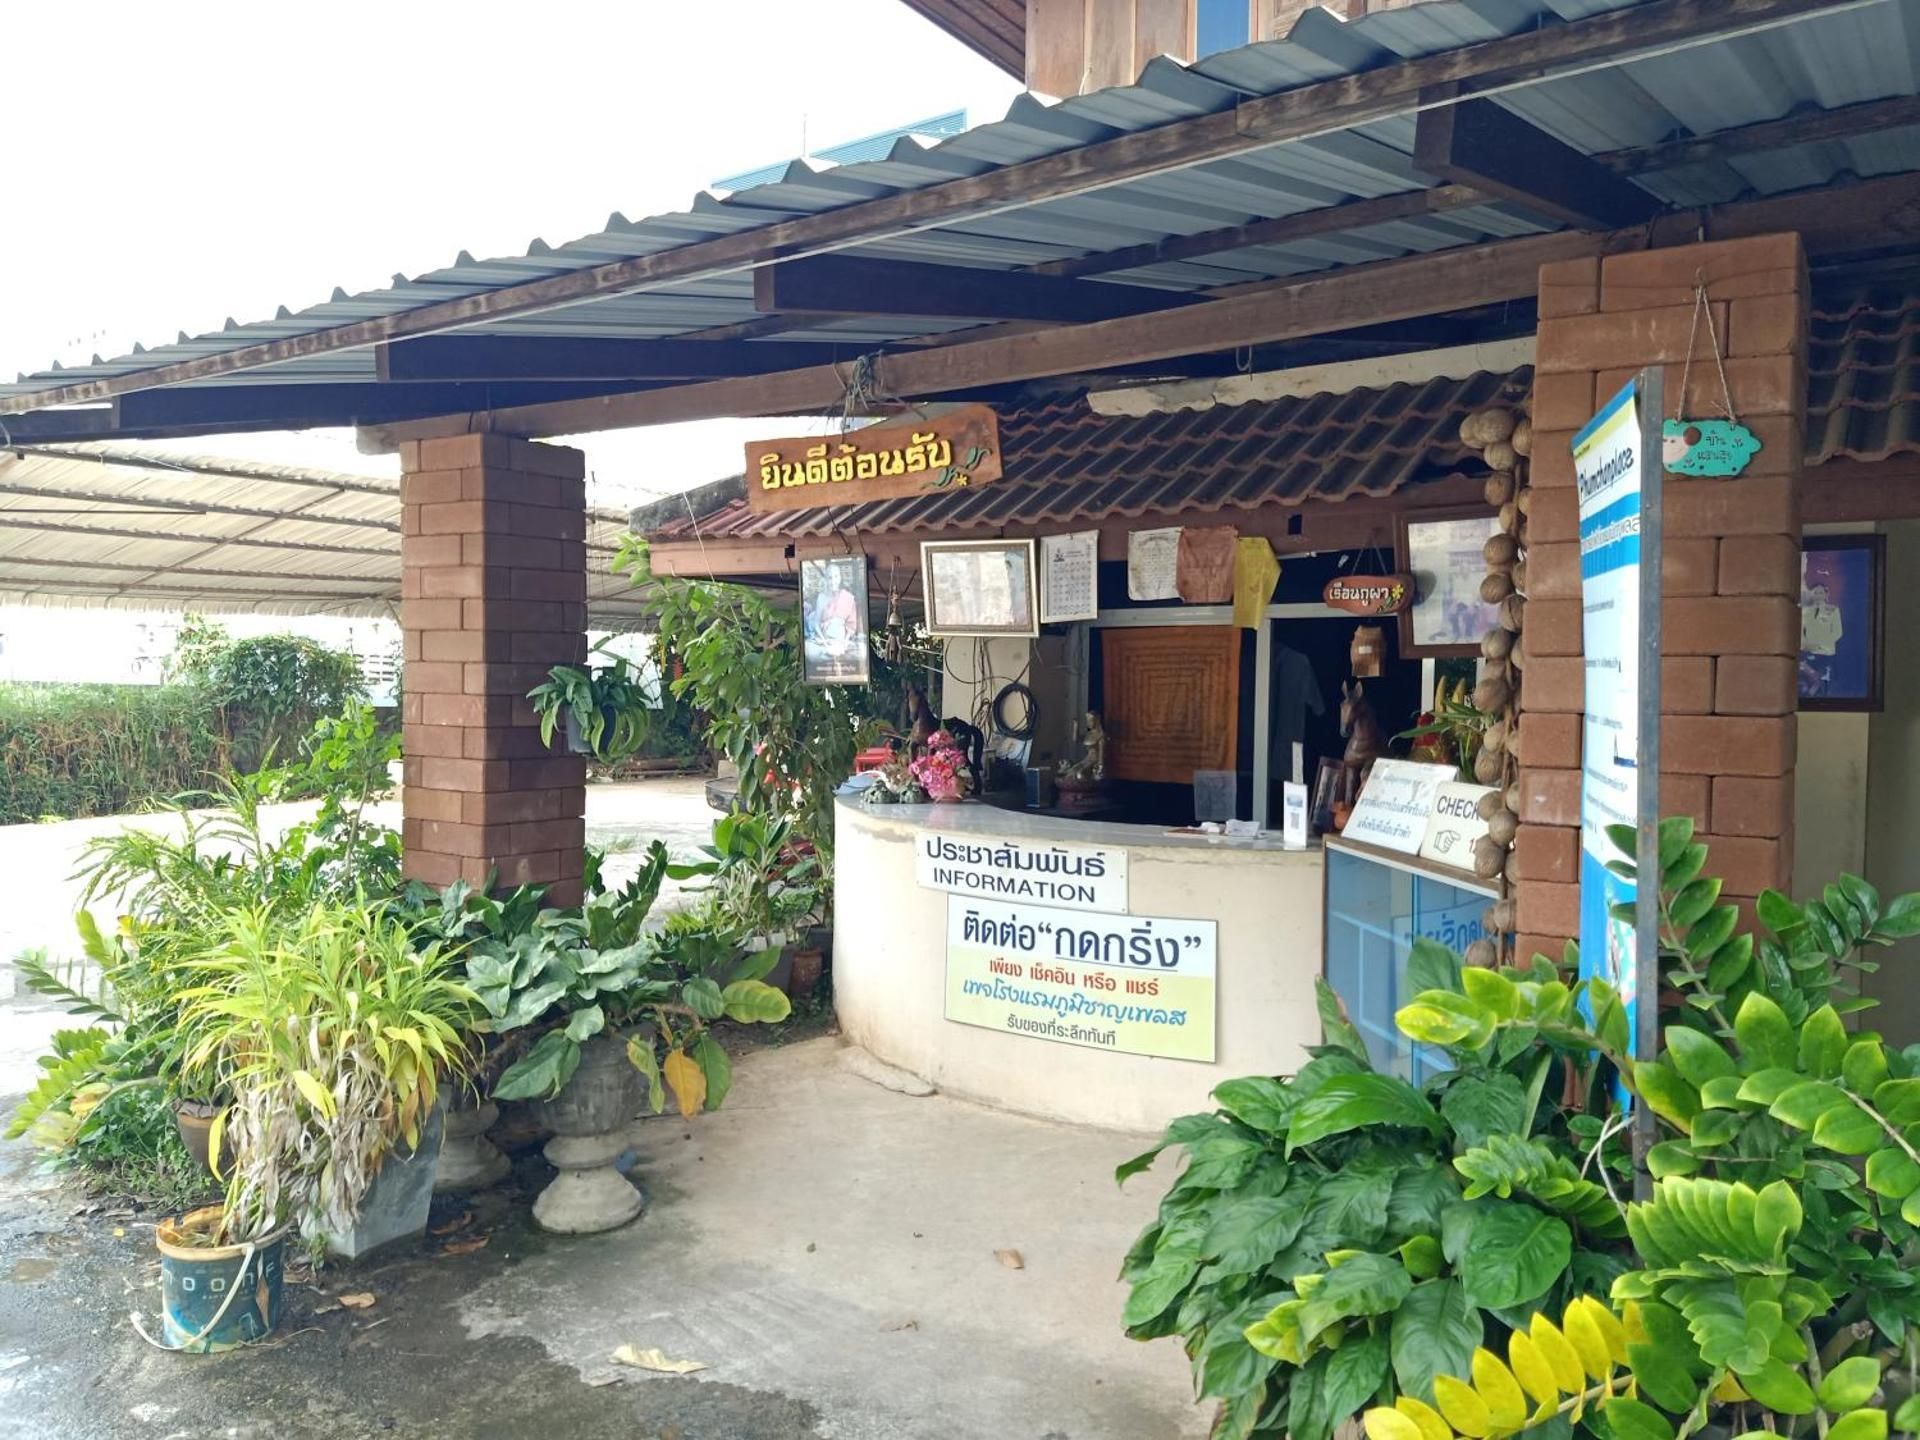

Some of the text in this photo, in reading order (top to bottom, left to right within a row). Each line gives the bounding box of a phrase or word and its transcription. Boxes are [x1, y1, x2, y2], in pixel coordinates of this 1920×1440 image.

[760, 433, 952, 490] ยินดีต้อนรับ
[926, 837, 1106, 877] ประชาสัมพันธ์
[933, 868, 1096, 903] INFORMATION
[989, 959, 1160, 997] เพียง เช็คอิน หรือ แชร์
[1006, 1014, 1116, 1046] รับของที่ระลึกทันที
